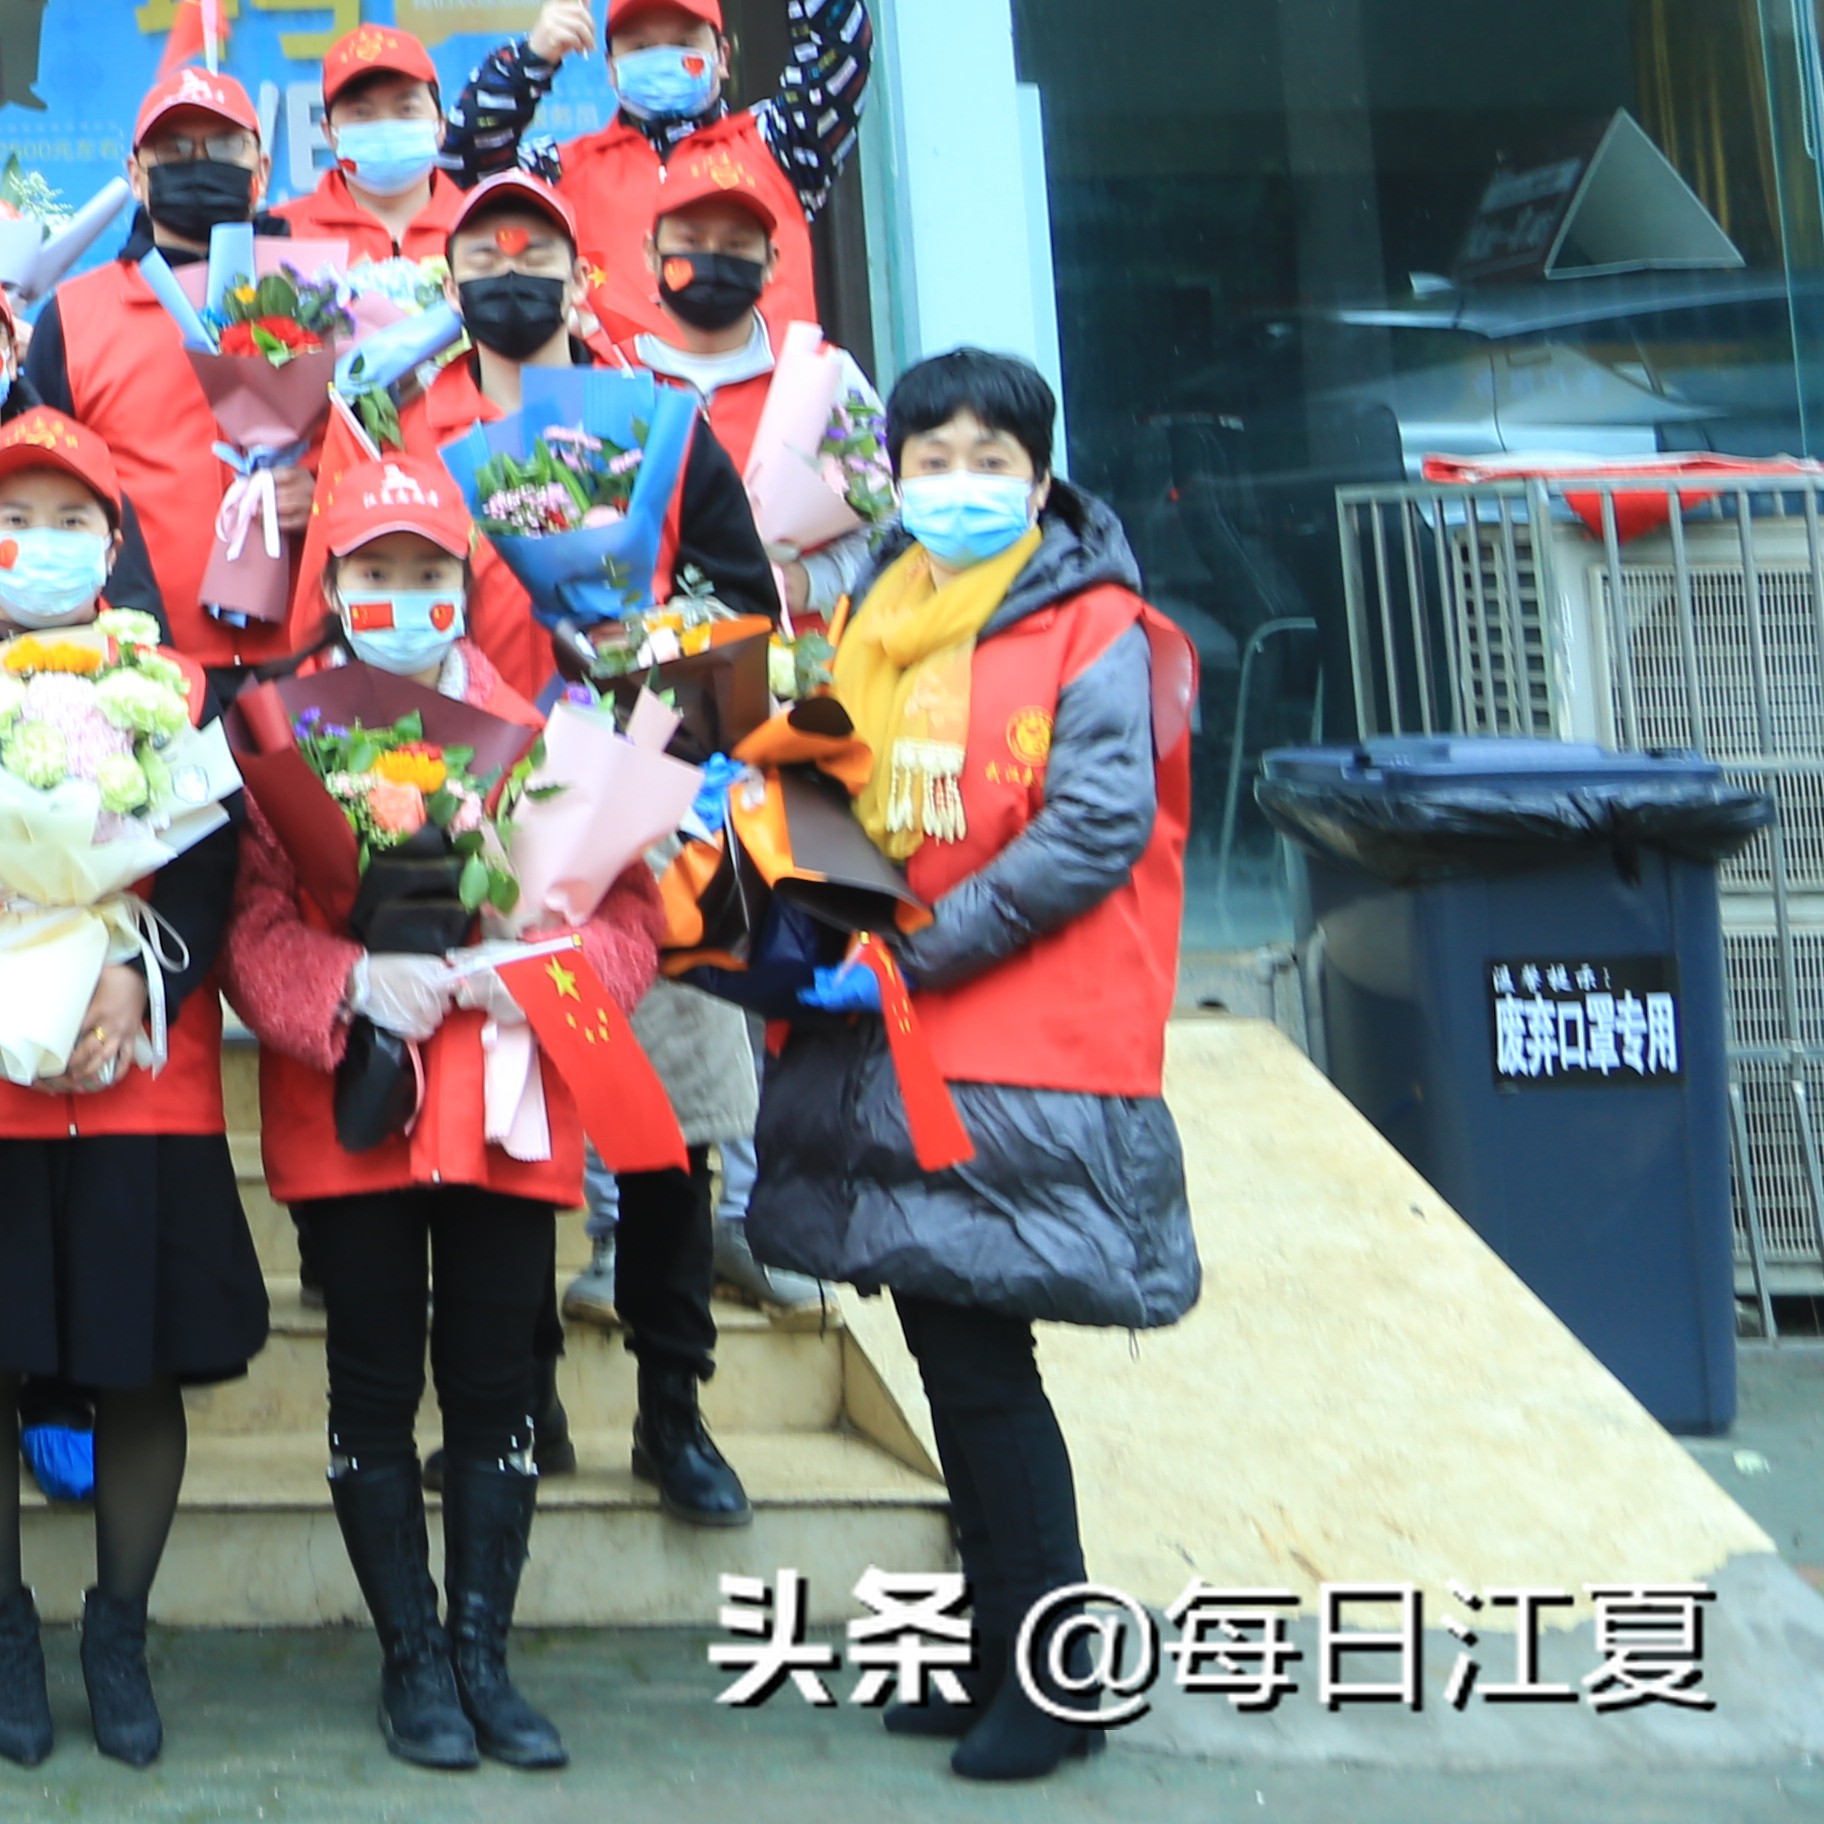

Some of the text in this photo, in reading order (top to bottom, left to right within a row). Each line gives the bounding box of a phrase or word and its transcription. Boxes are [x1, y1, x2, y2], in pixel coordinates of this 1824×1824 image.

[1494, 988, 1678, 1078] 废弃口罩专用
